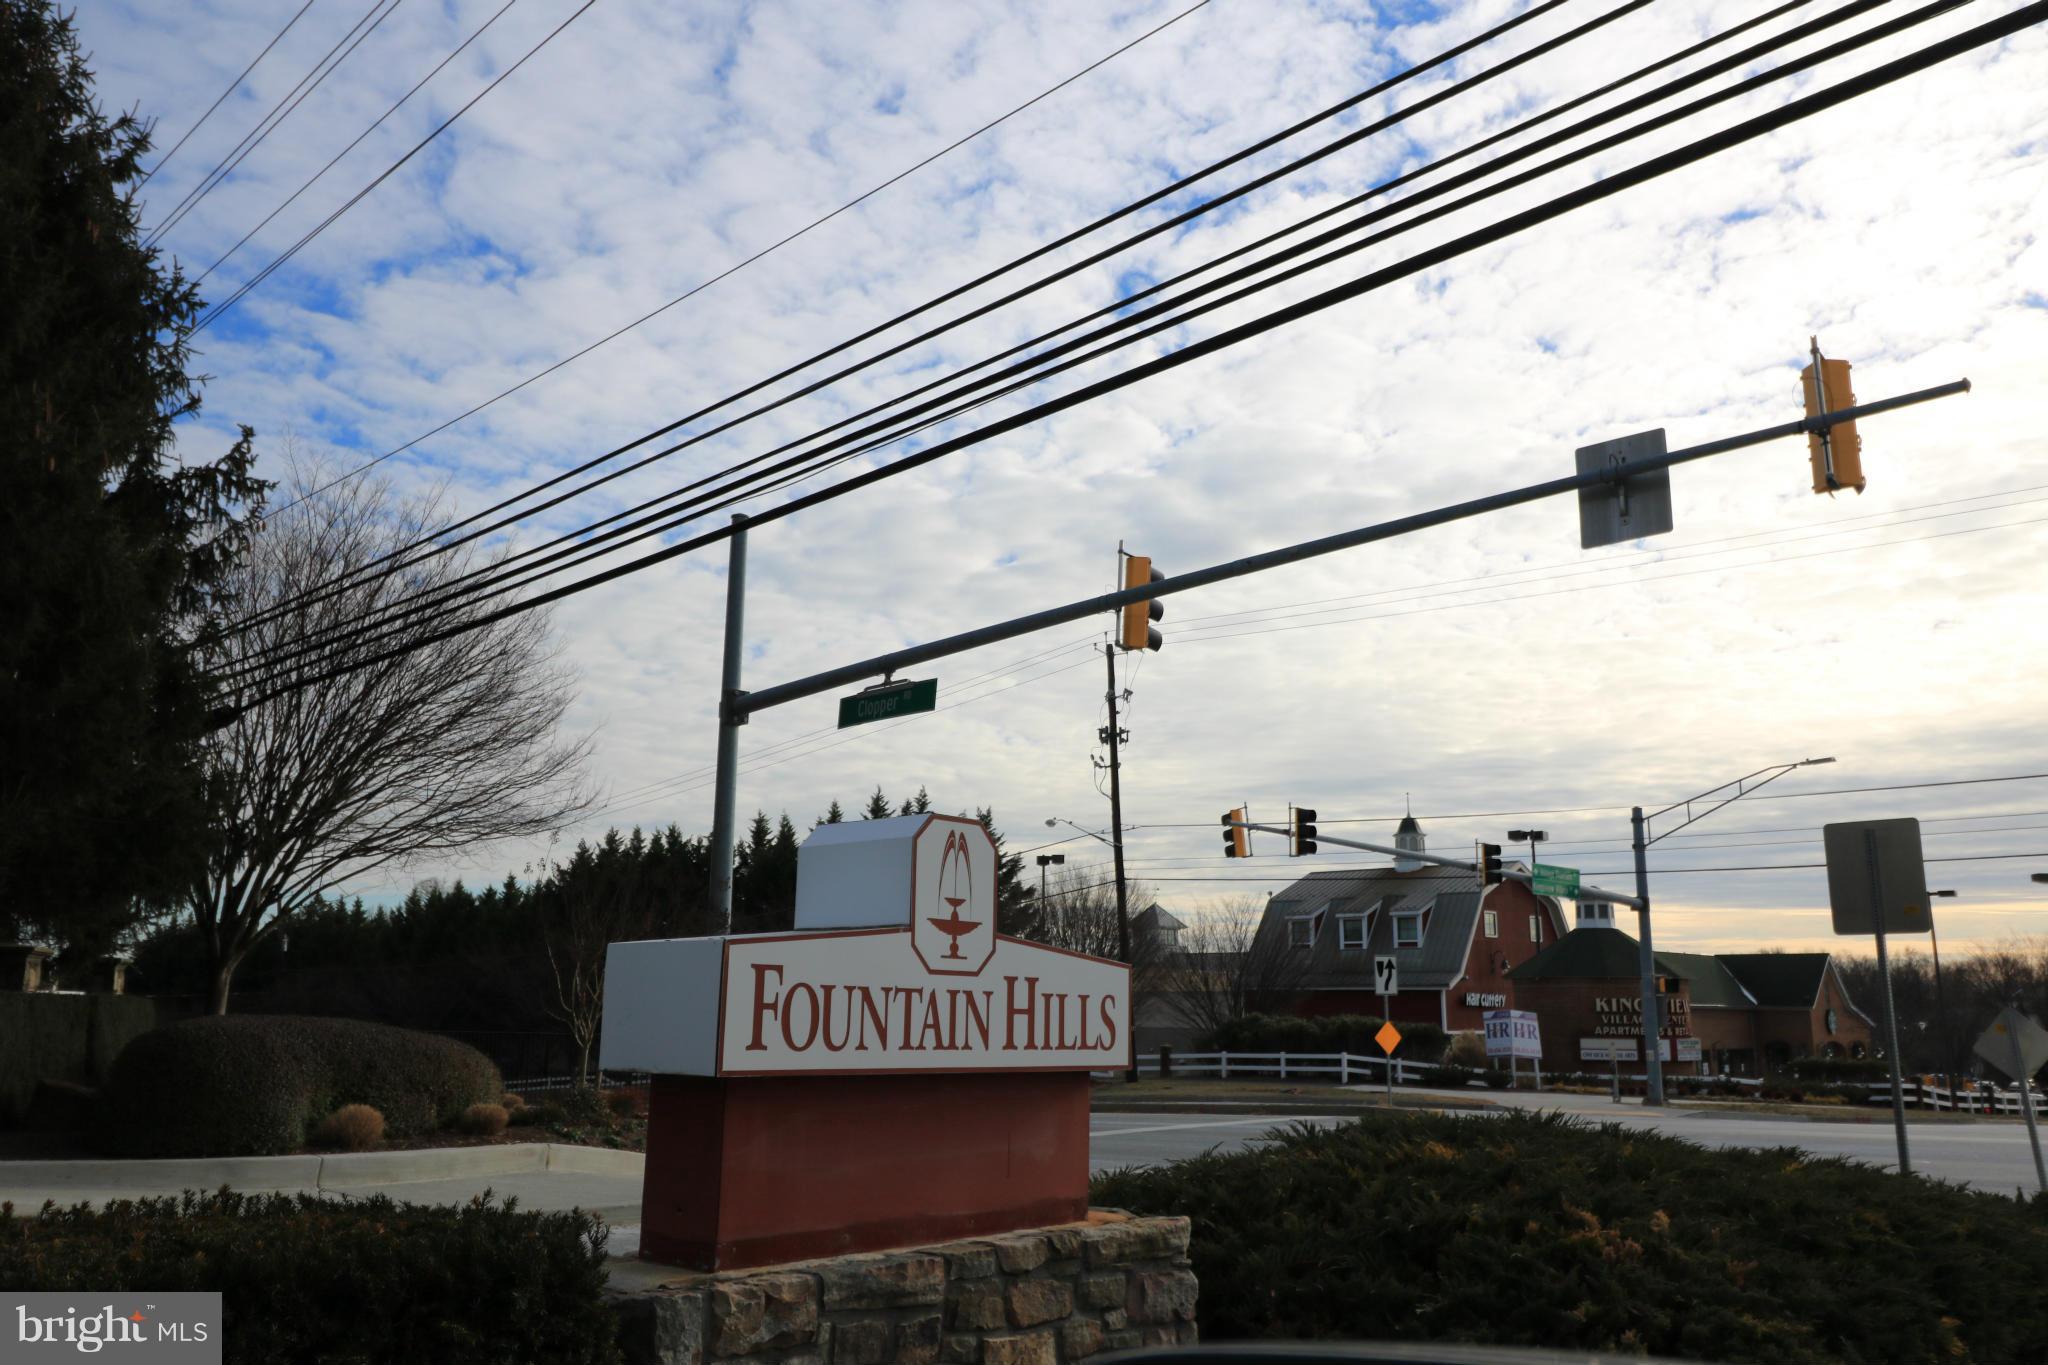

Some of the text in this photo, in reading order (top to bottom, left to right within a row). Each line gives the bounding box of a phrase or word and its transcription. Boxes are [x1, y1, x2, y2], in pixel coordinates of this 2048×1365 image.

[857, 695, 900, 718] Clopper
[745, 963, 1117, 1053] FOUNTAIN HILLS
[1466, 992, 1480, 1007] Hair
[1594, 1026, 1664, 1036] APARTMES
